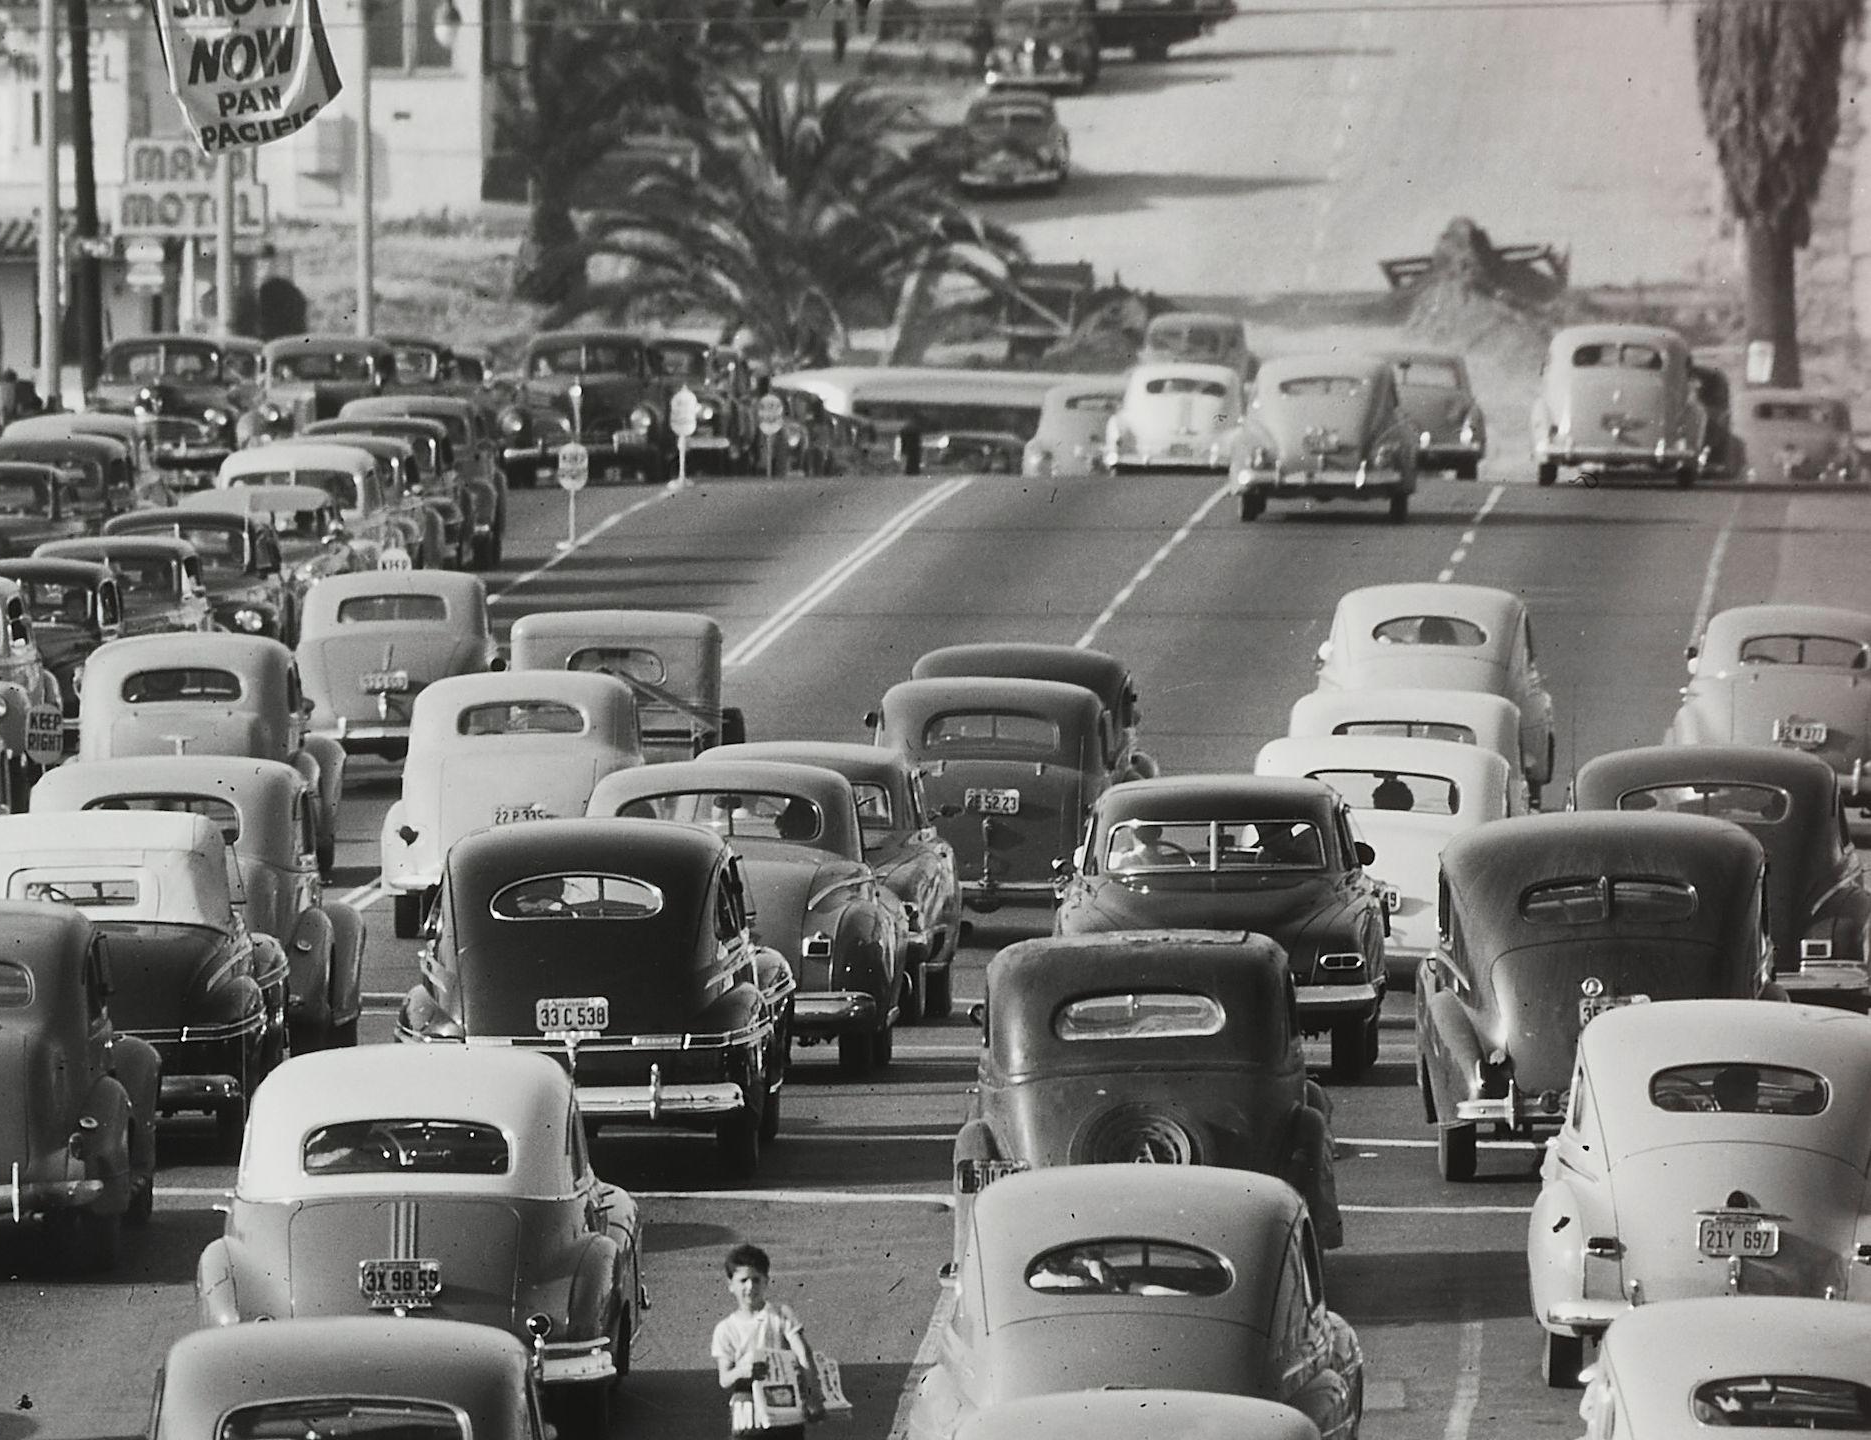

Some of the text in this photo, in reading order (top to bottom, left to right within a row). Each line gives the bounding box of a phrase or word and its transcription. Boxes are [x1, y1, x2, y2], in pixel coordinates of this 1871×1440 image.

[188, 27, 295, 85] NOW
[218, 85, 281, 117] PAN
[201, 103, 320, 151] PACIFIC
[121, 193, 260, 227] MOTL
[29, 712, 62, 730] KEEP
[28, 732, 62, 751] RIGHT
[540, 1006, 606, 1026] 33 C 538
[1743, 1230, 1771, 1250] 697
[366, 1269, 439, 1292] 3X 98 59
